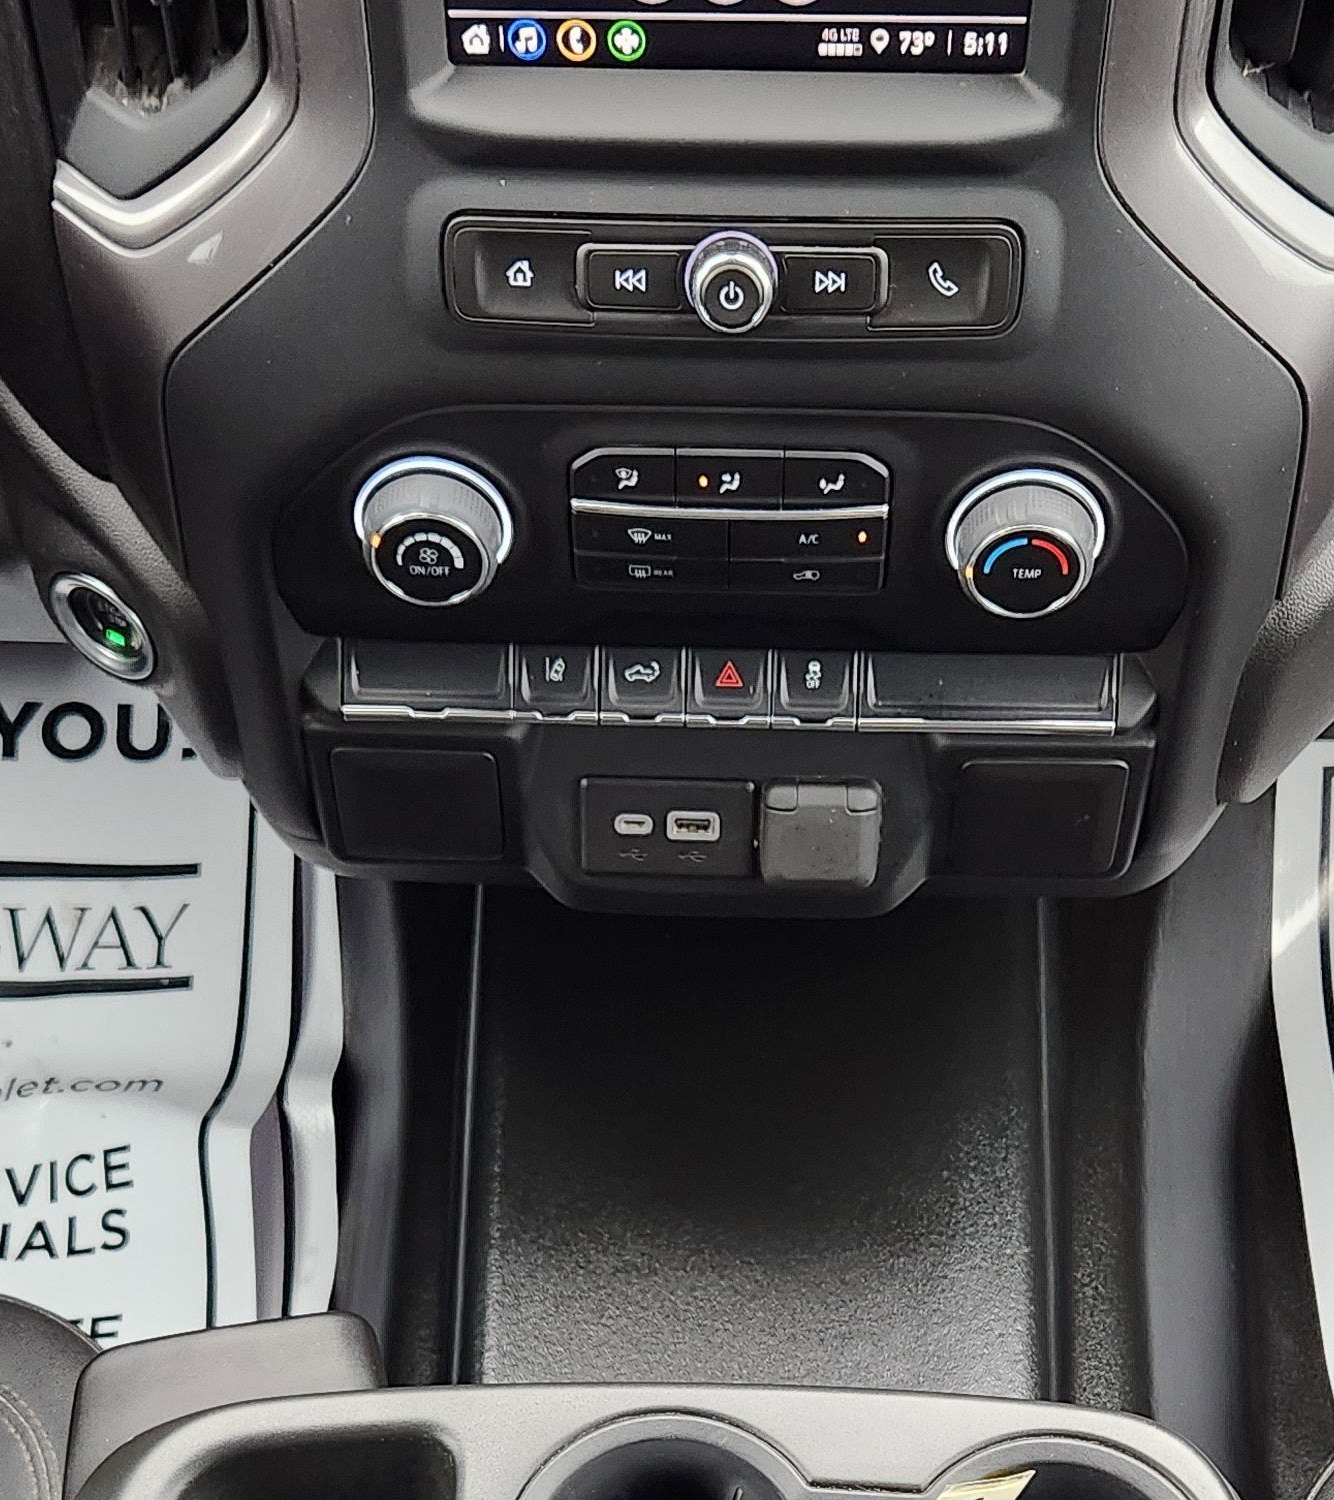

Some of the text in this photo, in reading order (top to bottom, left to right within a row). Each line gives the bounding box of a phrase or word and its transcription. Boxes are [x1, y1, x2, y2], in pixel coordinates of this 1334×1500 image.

[821, 27, 860, 42] 4G LTE
[963, 30, 1008, 57] 5:11
[654, 533, 672, 541] MAX
[798, 533, 819, 545] A/C
[409, 564, 450, 577] ON/OFF
[1012, 567, 1042, 579] TEMP
[805, 678, 821, 689] OFF
